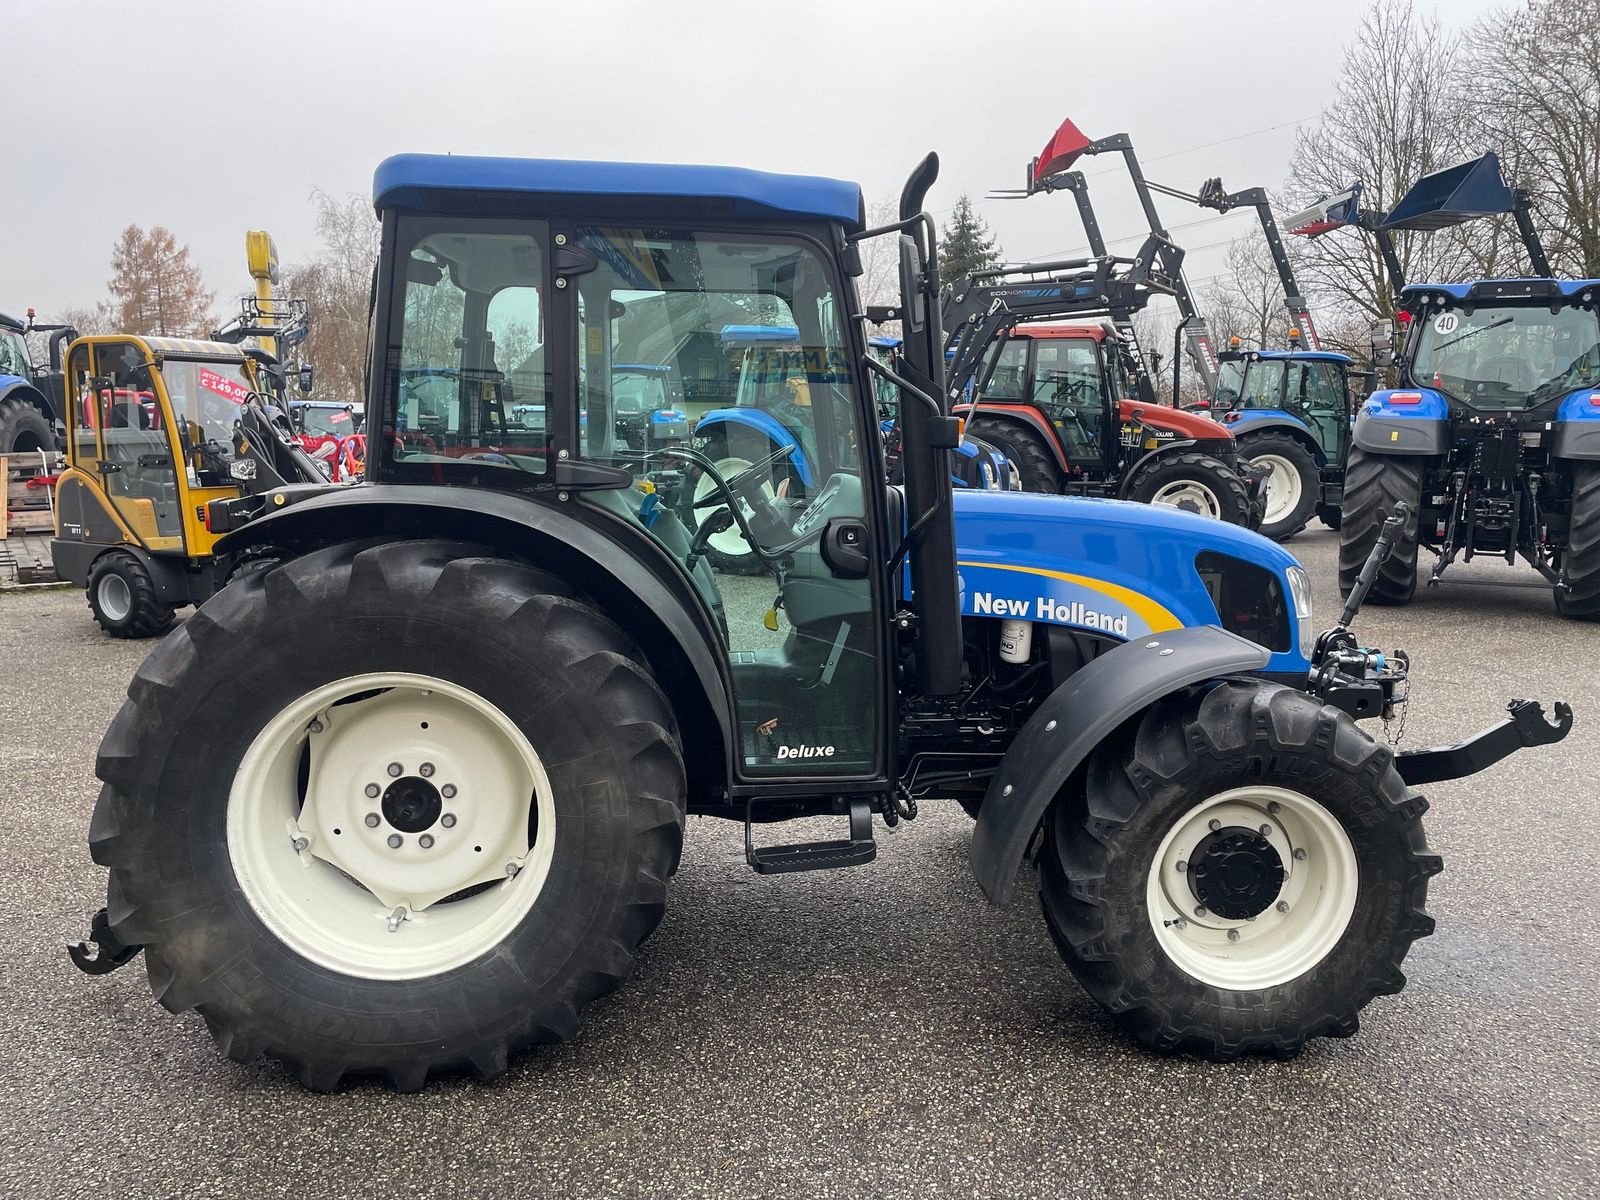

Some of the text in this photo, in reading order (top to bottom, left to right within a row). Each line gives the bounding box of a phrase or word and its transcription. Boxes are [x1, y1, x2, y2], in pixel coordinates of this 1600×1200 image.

[990, 289, 1032, 297] ECONOMY
[1437, 316, 1454, 331] 40
[1198, 342, 1217, 374] FARESIN
[973, 592, 1030, 617] New
[1036, 597, 1128, 637] Holland
[776, 744, 835, 759] Deluxe
